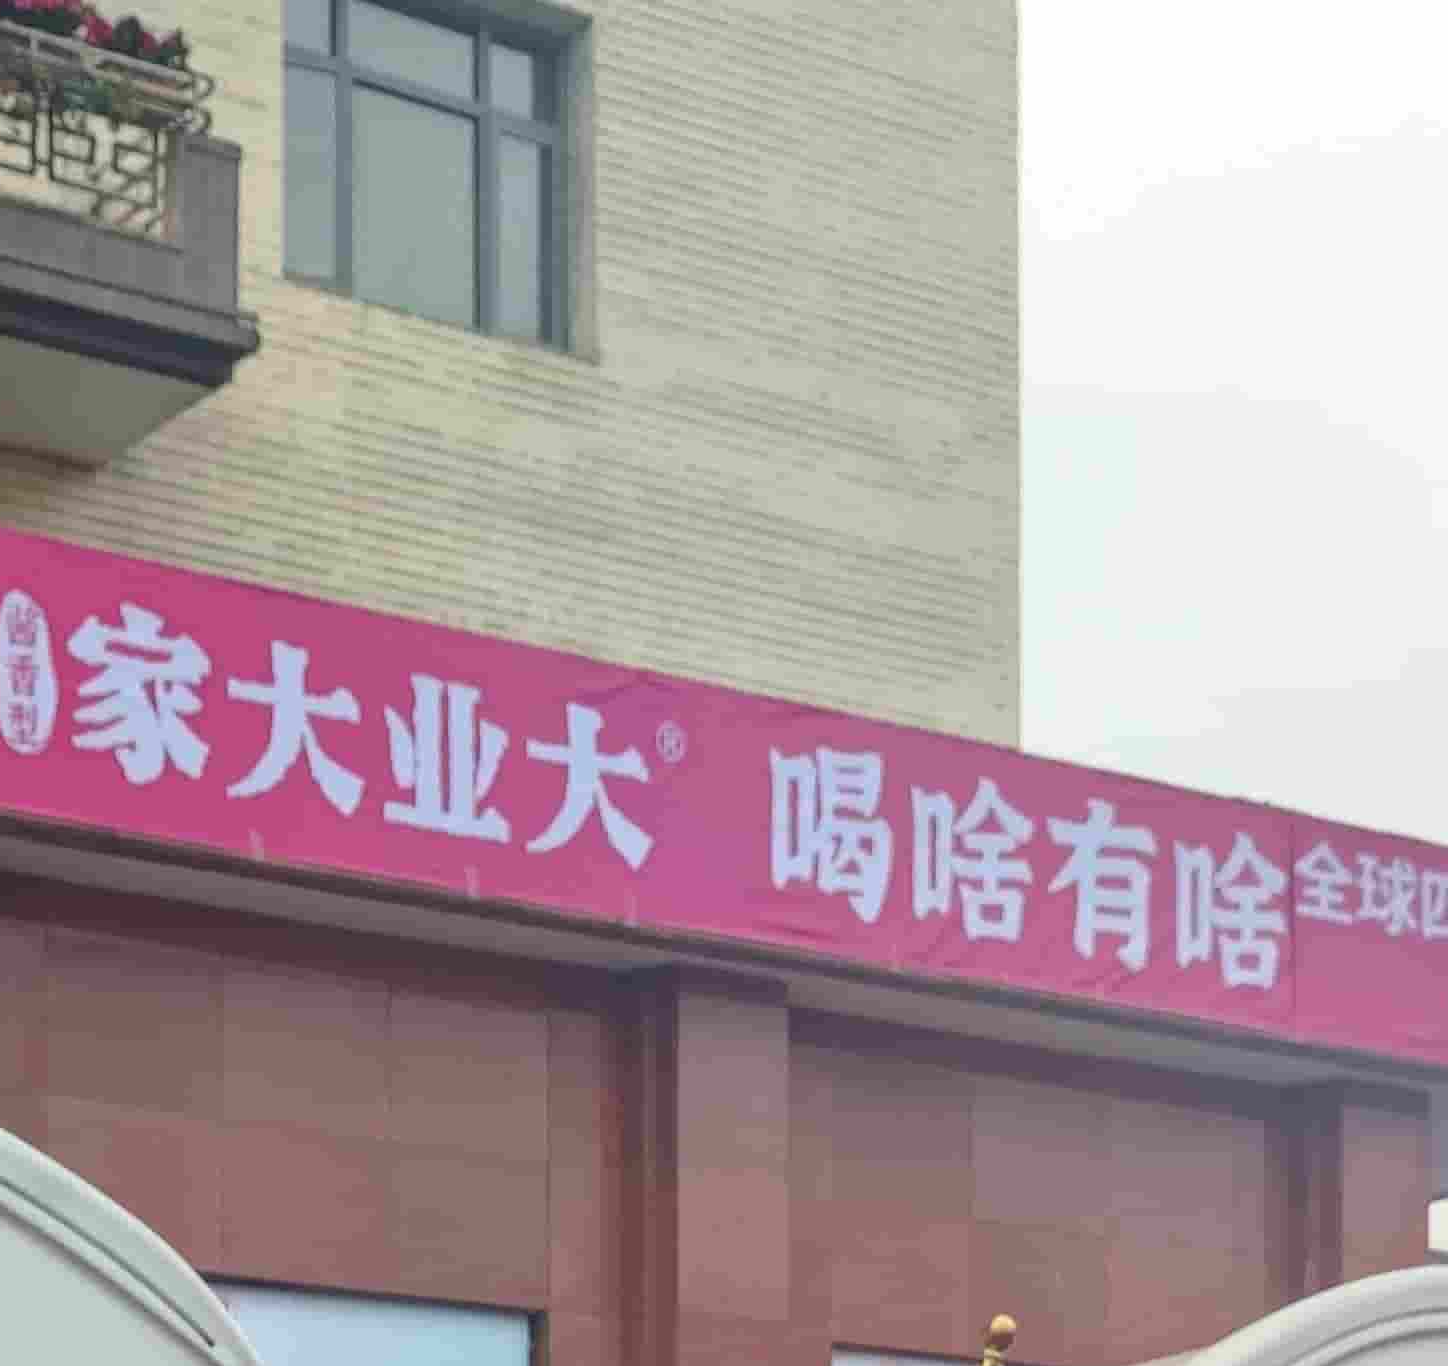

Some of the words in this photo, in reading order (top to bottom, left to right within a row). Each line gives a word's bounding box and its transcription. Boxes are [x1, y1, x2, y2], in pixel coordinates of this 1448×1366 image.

[67, 601, 654, 872] 家大业大
[769, 745, 1289, 992] 喝啥有啥
